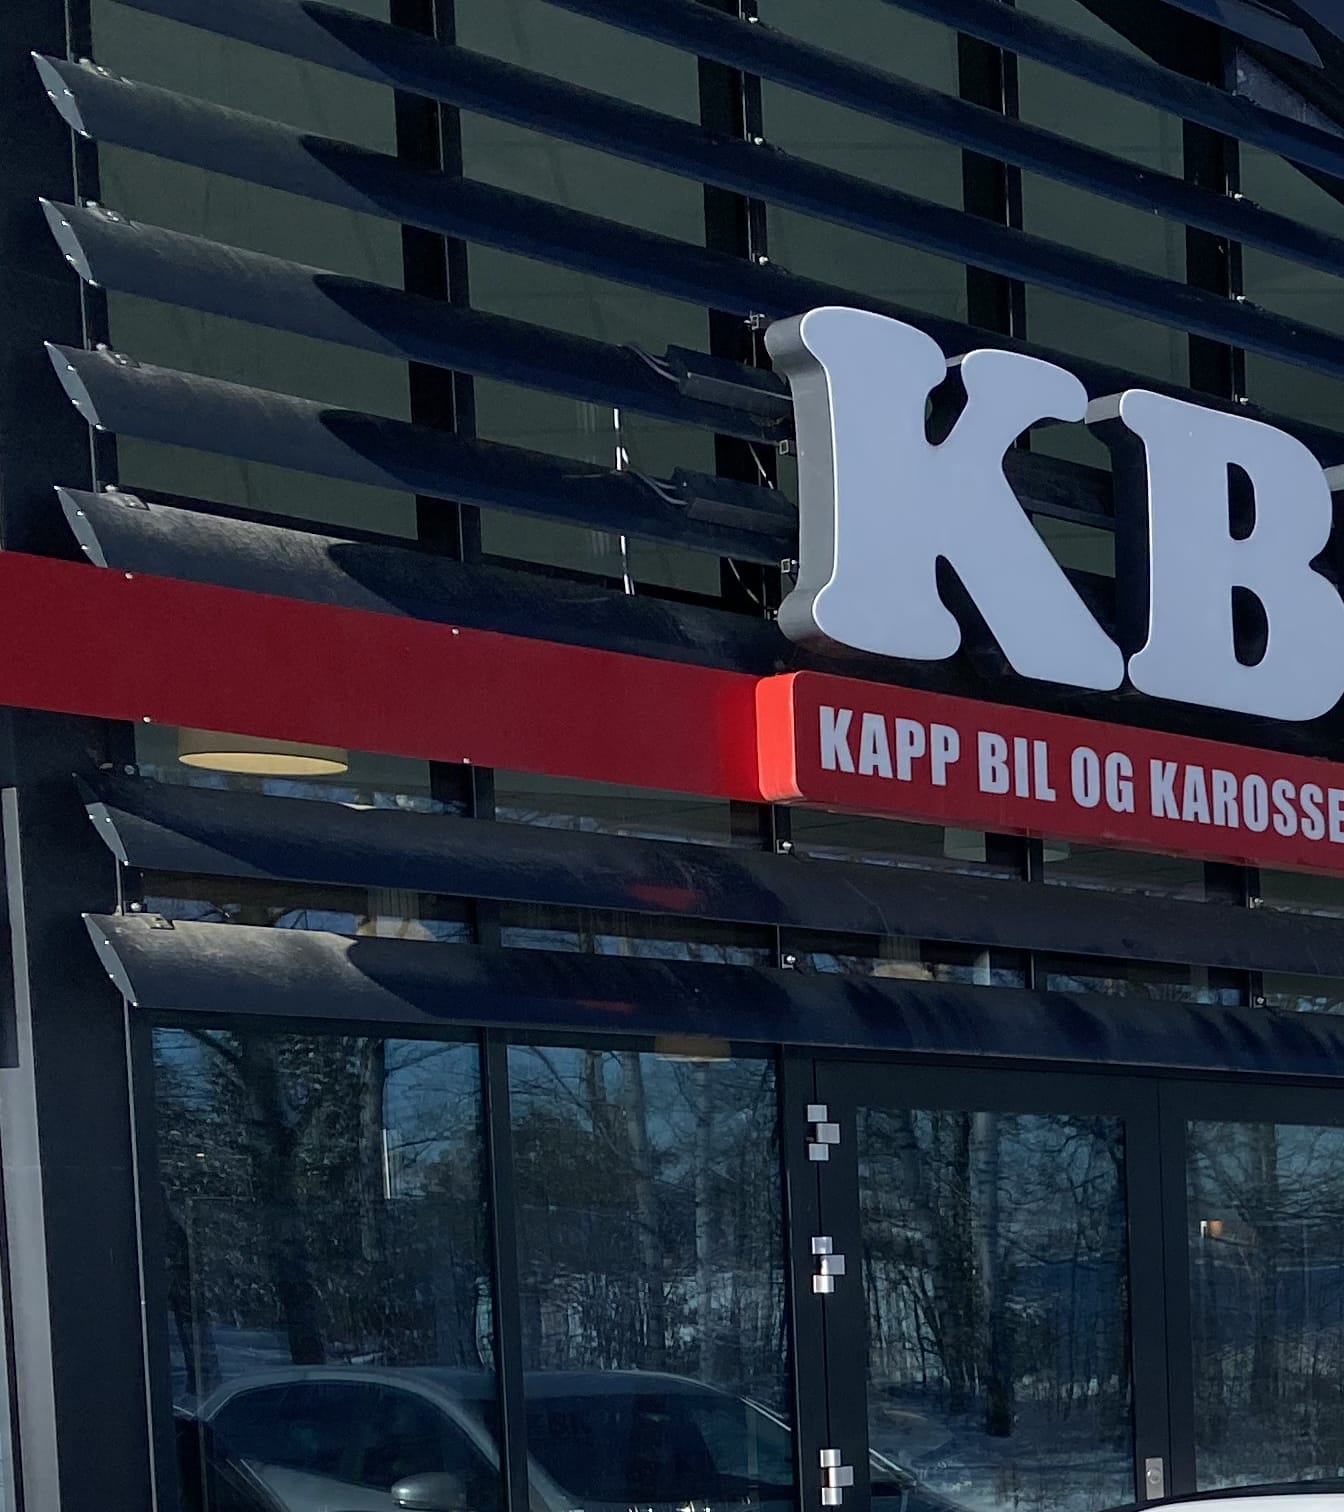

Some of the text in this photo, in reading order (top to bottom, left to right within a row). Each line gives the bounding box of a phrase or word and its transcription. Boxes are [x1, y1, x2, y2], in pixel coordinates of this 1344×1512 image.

[818, 704, 960, 788] KAPP
[976, 729, 1057, 804] BIL
[1070, 747, 1135, 814] OG
